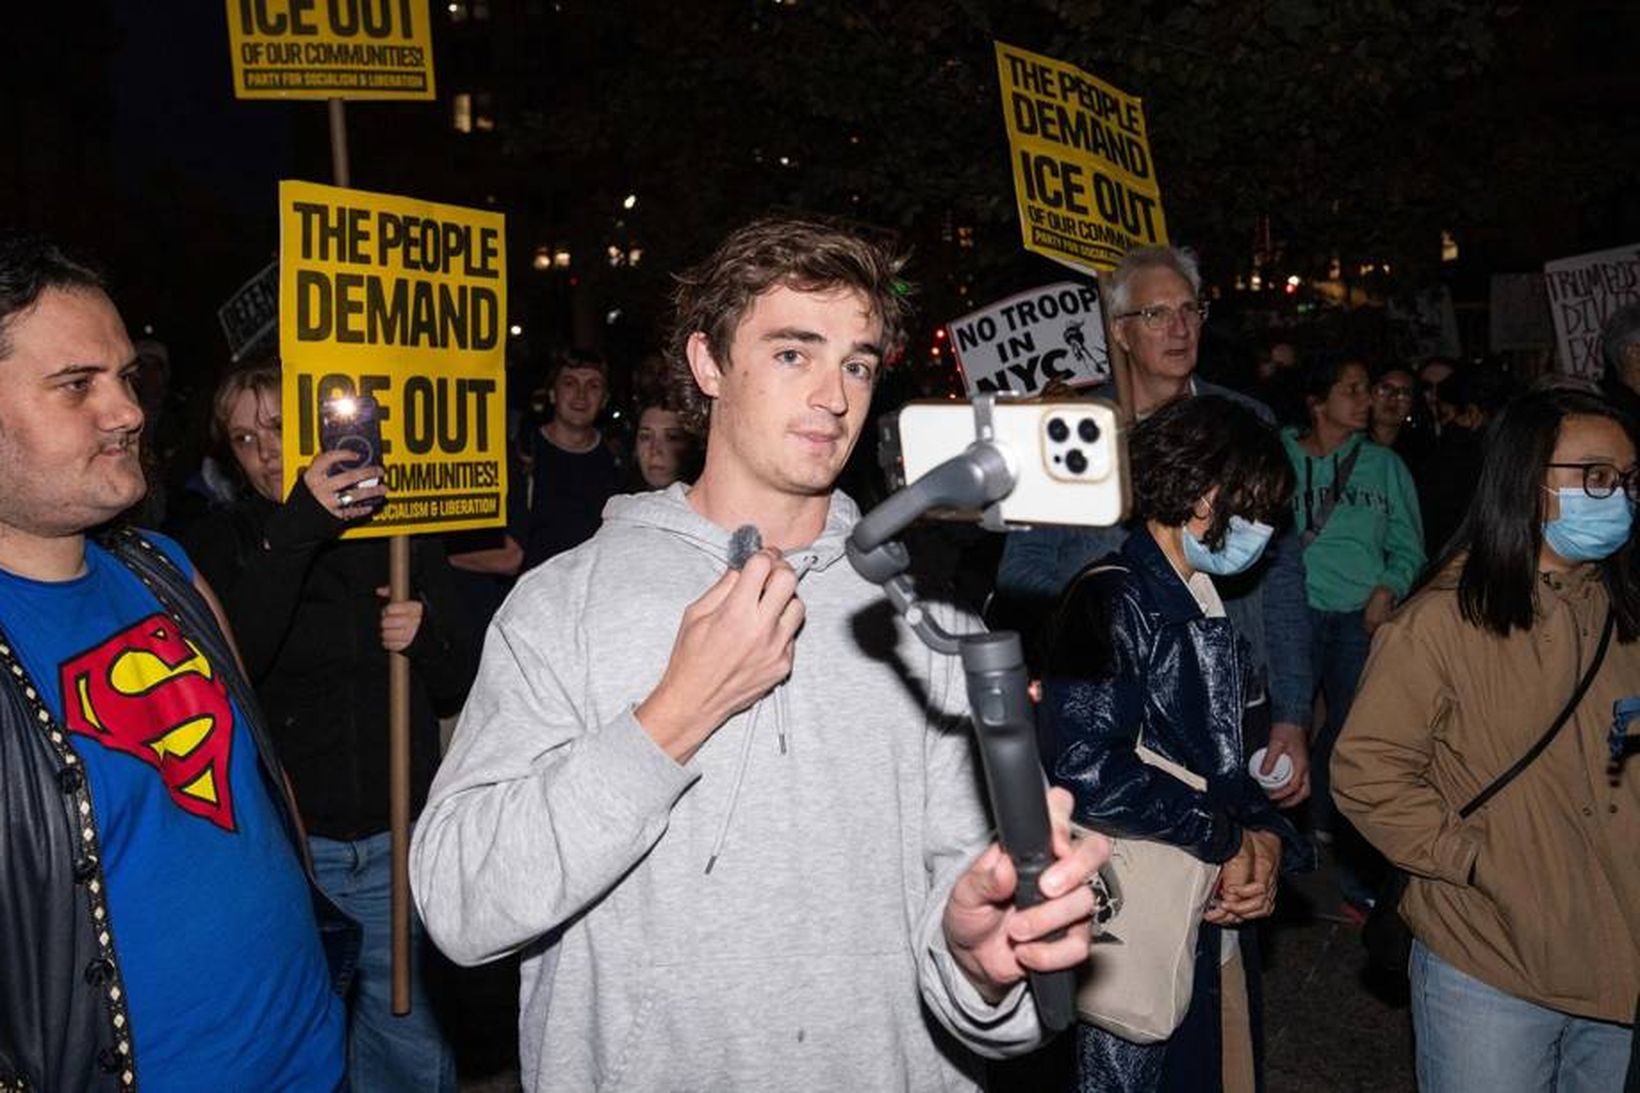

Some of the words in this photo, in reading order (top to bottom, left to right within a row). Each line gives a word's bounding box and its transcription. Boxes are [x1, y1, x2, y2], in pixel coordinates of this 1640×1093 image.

[241, 42, 264, 65] OF
[267, 42, 302, 65] OUR
[305, 43, 425, 67] COMMUNITIES!
[1005, 53, 1057, 99] THE
[1058, 70, 1141, 136] PEOPLE
[1012, 92, 1149, 179] DEMAND
[1021, 151, 1089, 215] ICE
[1093, 172, 1156, 244] OUT
[1028, 205, 1047, 226] OF
[1048, 211, 1077, 237] OUR
[293, 202, 371, 265] THE
[378, 212, 499, 279] PEOPLE
[297, 270, 498, 350] DEMAND
[956, 317, 996, 352] NO
[1001, 288, 1097, 331] TROOP
[976, 349, 1077, 392] NYC
[997, 332, 1035, 364] IN
[404, 375, 496, 455] OUT
[440, 498, 497, 515] LIBERATION
